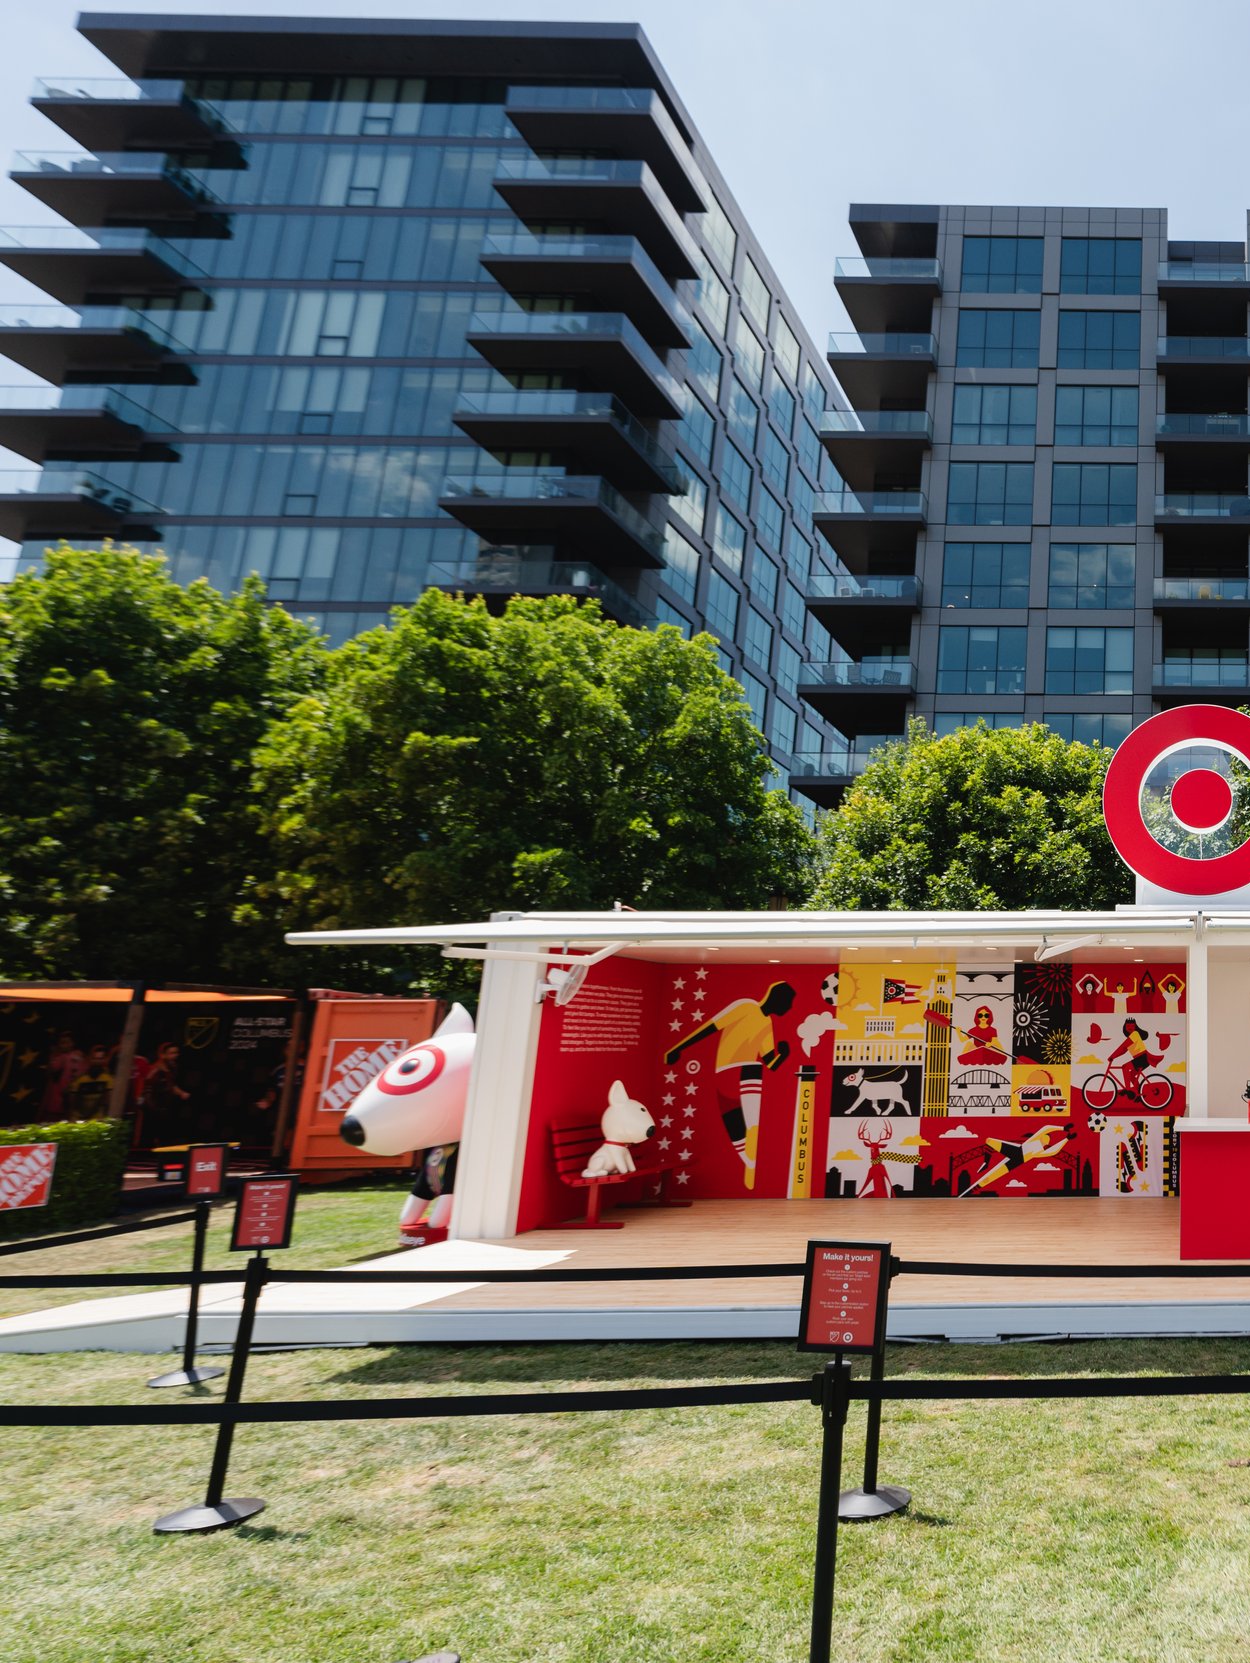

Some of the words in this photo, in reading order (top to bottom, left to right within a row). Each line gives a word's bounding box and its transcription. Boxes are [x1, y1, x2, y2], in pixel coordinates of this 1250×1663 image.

[334, 1046, 370, 1077] THE
[797, 1089, 810, 1184] COLUMBUS
[822, 1252, 843, 1261] Make
[844, 1253, 850, 1261] it
[850, 1254, 874, 1263] yours!
